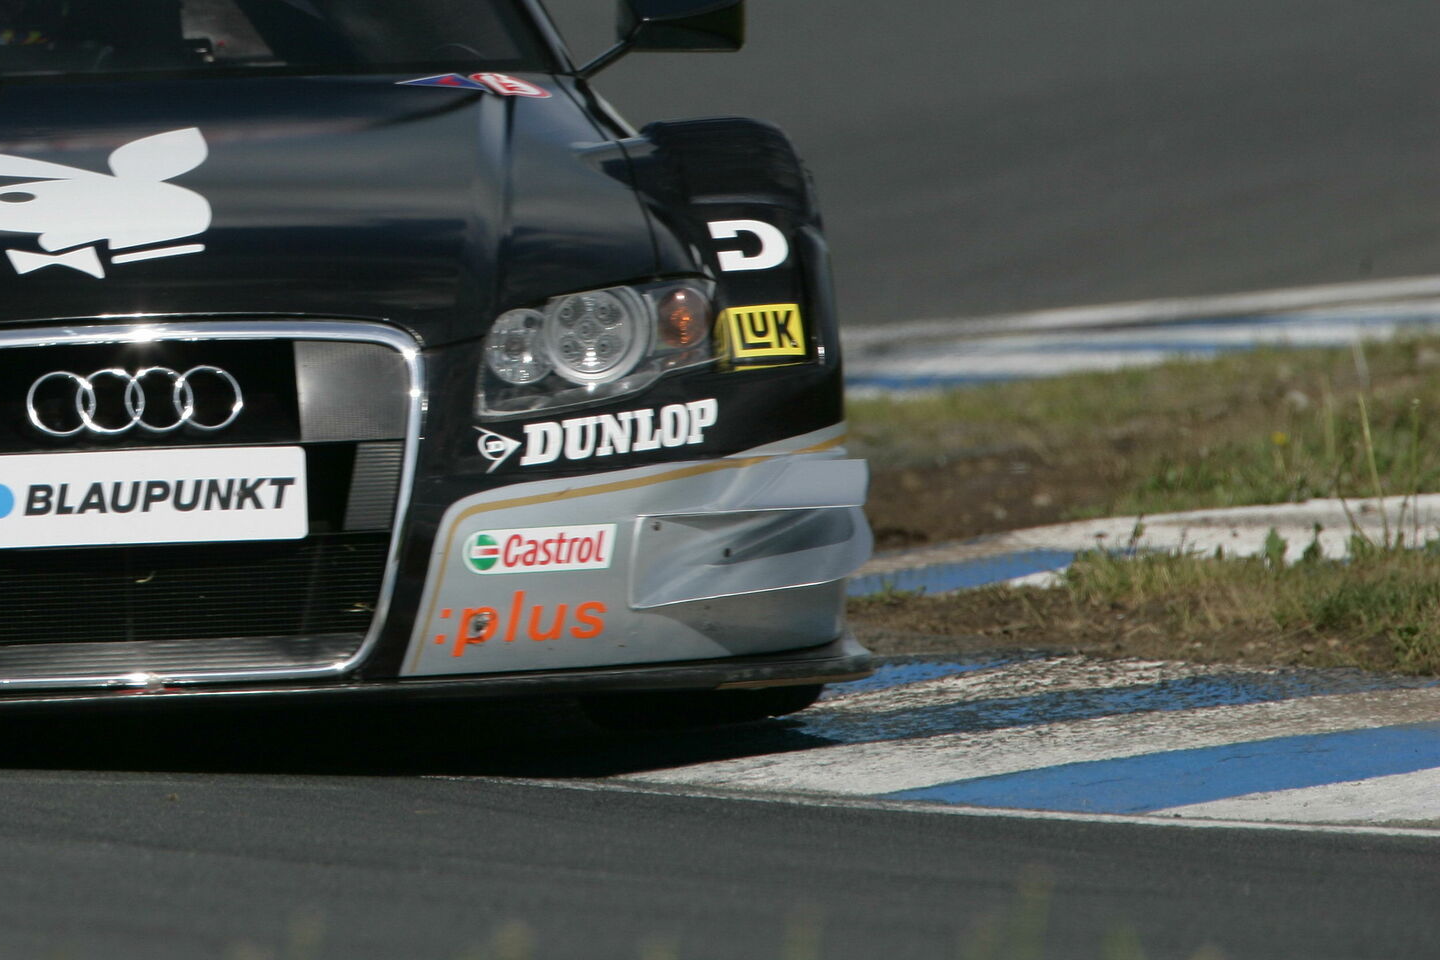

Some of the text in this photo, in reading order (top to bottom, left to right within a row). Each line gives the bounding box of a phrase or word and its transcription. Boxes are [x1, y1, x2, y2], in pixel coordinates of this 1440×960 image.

[520, 398, 718, 466] DUNLOP
[23, 476, 297, 517] BLAUPUNKT
[503, 529, 607, 568] Castrol
[434, 589, 609, 658] :plus
